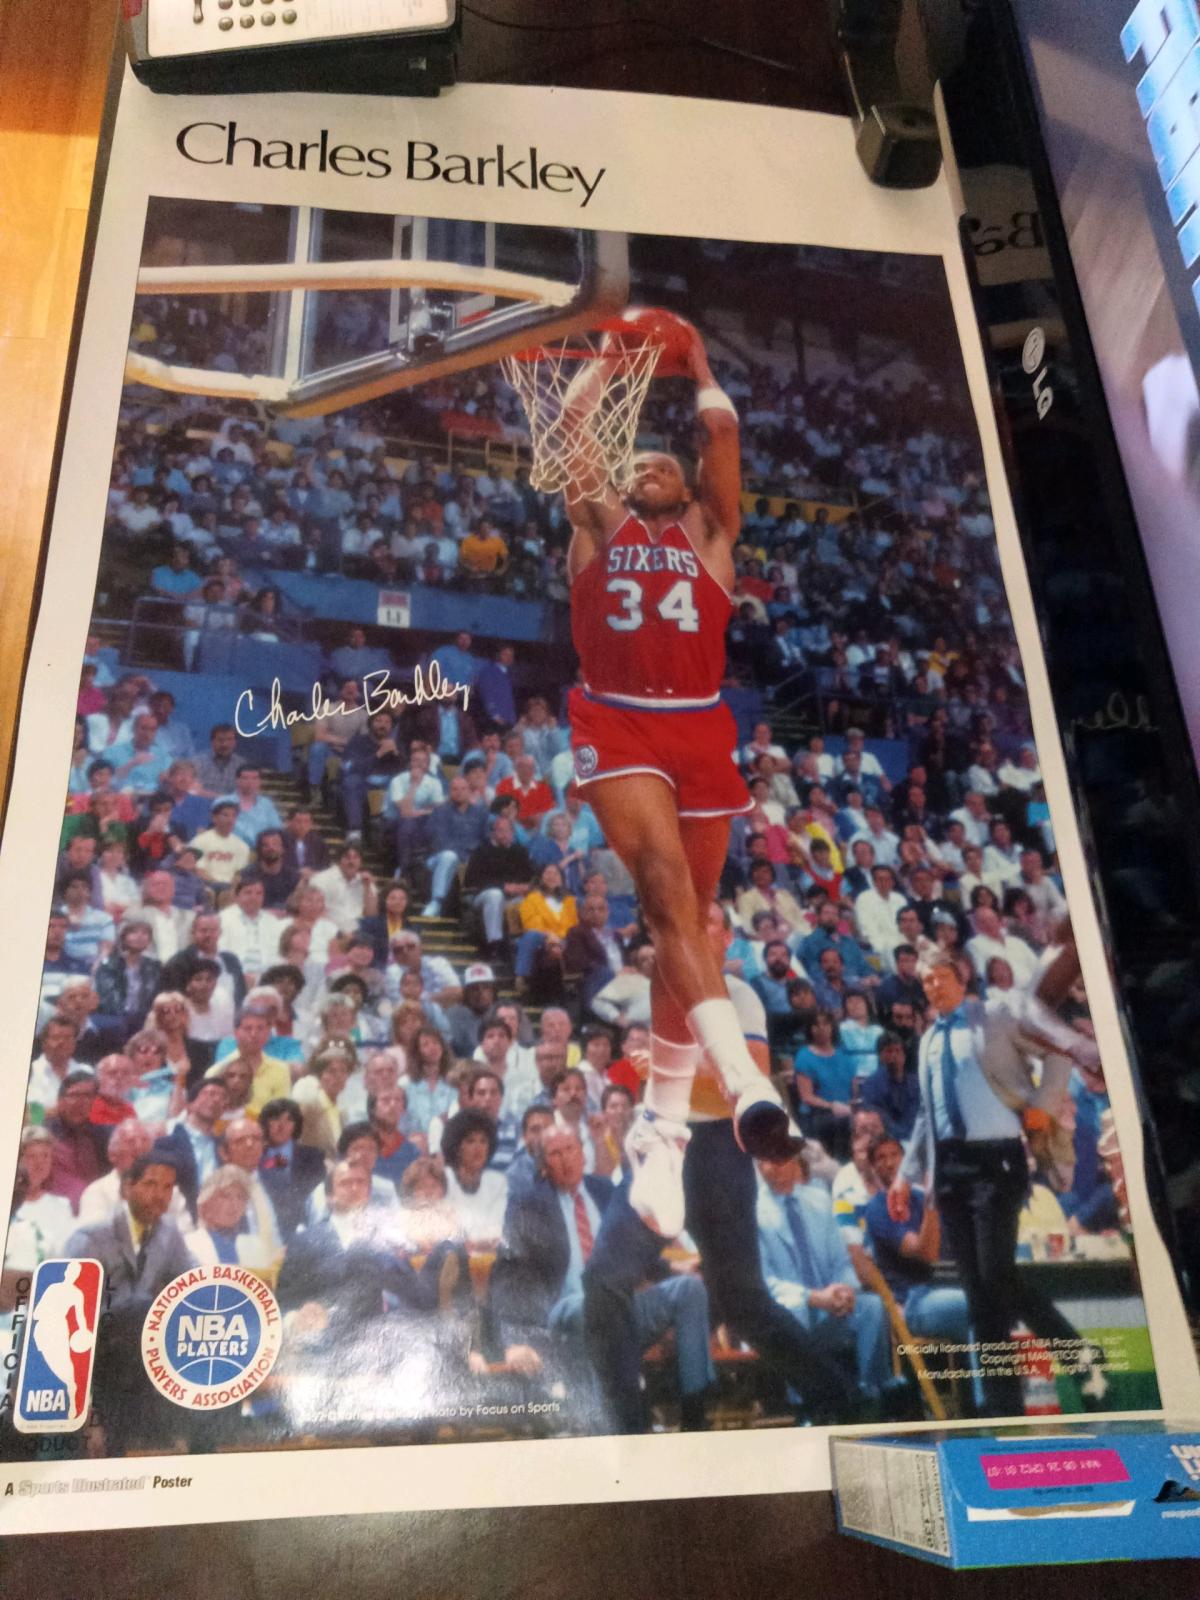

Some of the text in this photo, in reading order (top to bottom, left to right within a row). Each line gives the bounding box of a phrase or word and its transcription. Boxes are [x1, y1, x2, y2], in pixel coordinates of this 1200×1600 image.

[175, 120, 607, 208] Charles Barkley
[607, 544, 699, 579] SIXERS
[606, 578, 700, 632] 34
[235, 678, 366, 738] Charles
[148, 1266, 279, 1331] NATIONAL BASKETBALL
[177, 1314, 249, 1342] NBA
[177, 1341, 249, 1357] PLAYERS
[146, 1347, 275, 1406] PLAYERS ASSOCIATION
[26, 1389, 66, 1413] NBA
[459, 1404, 473, 1417] by
[476, 1403, 508, 1416] Focus
[511, 1403, 525, 1414] on
[528, 1400, 560, 1414] Sports
[5, 1482, 14, 1497] A
[18, 1479, 70, 1498] Sports
[153, 1475, 193, 1489] Poster
